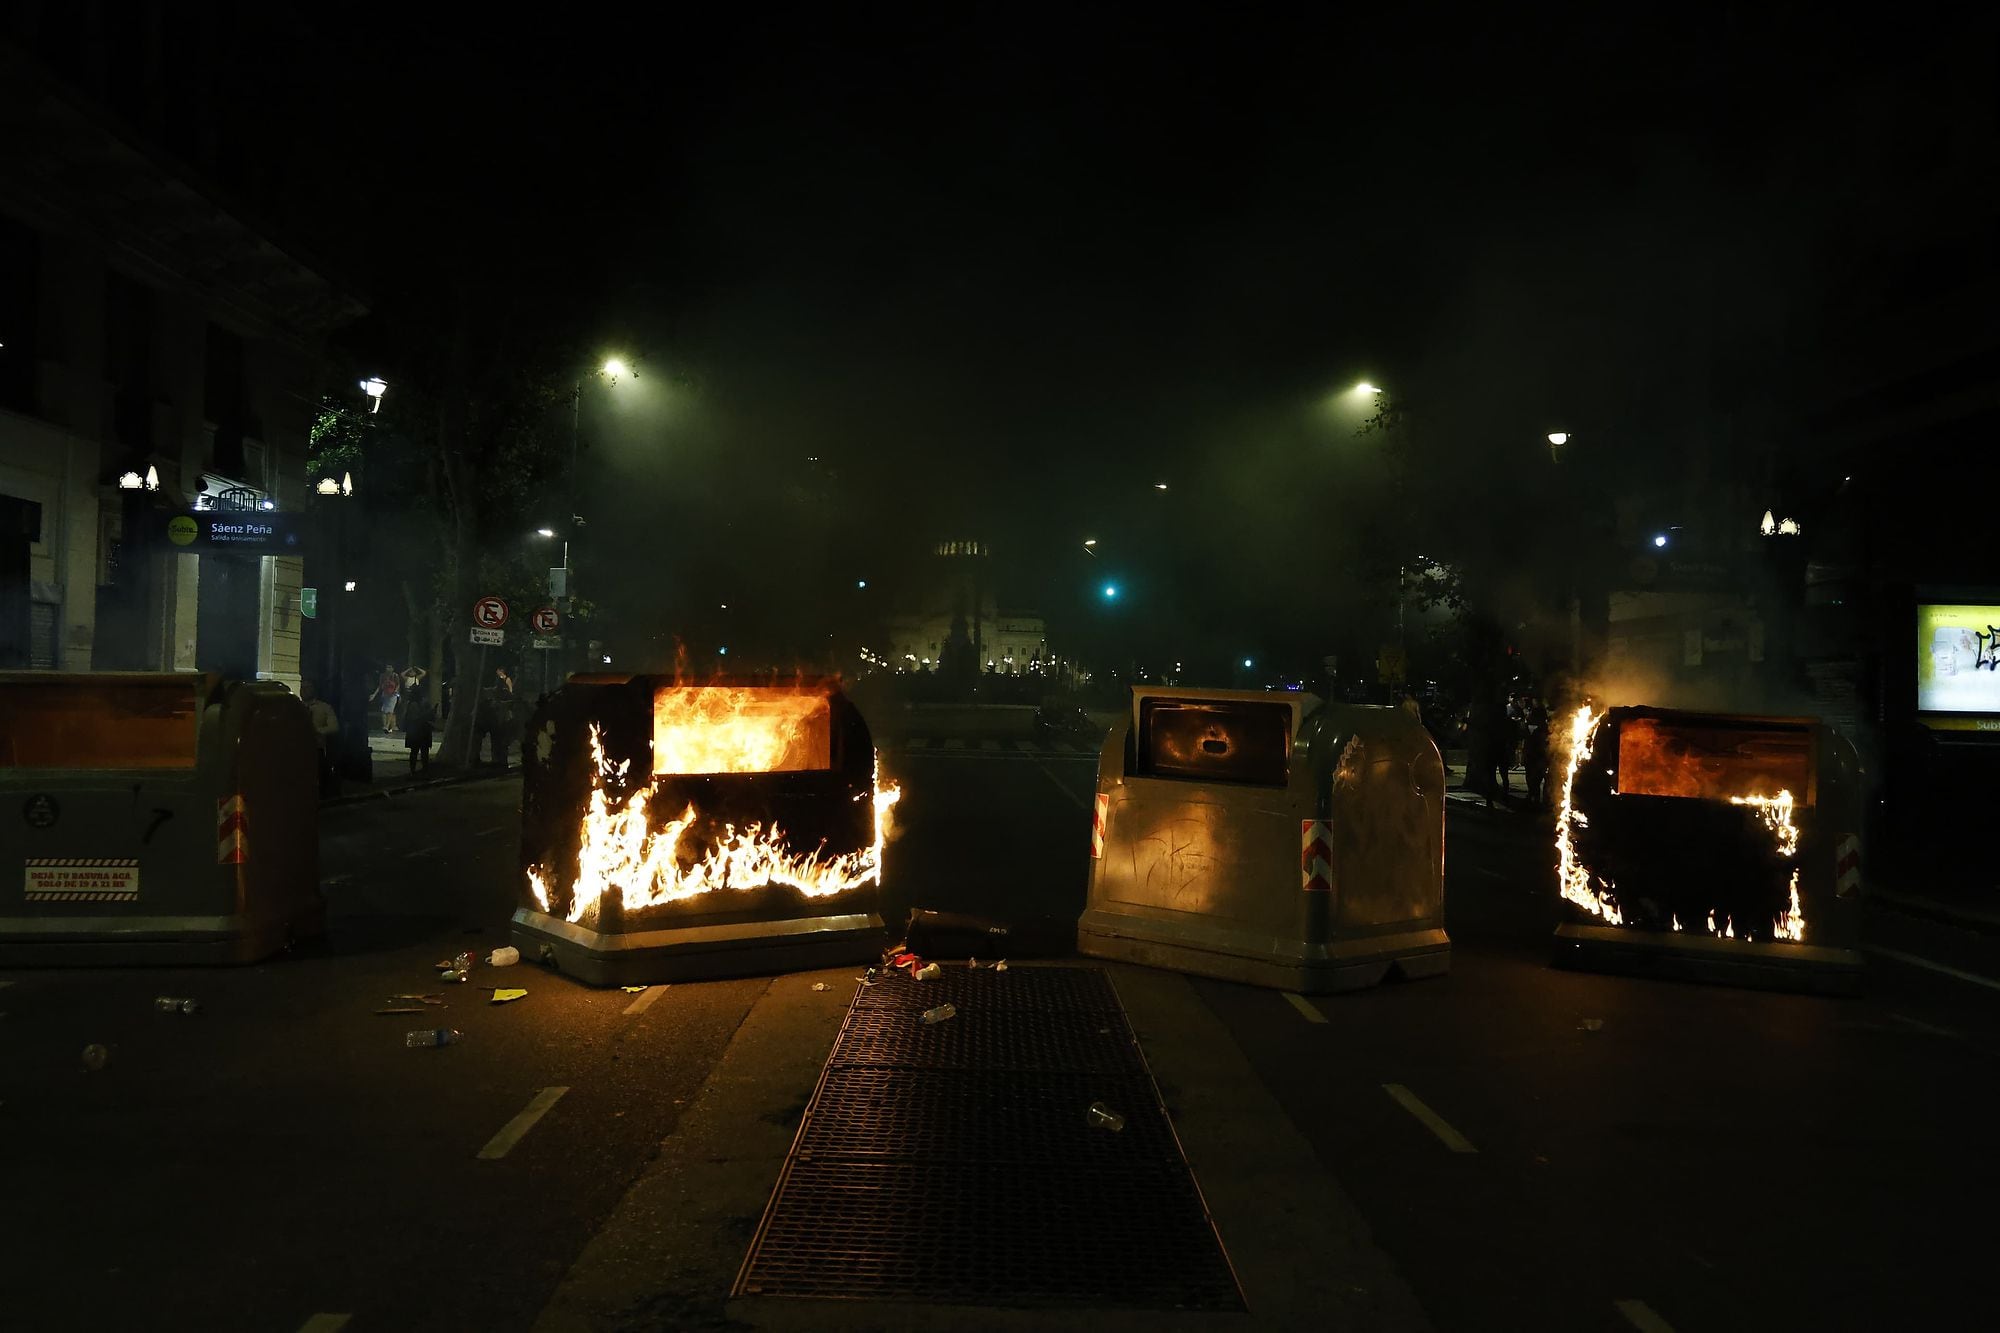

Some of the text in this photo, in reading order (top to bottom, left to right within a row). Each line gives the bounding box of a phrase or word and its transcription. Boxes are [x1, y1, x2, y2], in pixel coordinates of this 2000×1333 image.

[211, 521, 273, 535] Sáenz Peña
[58, 872, 70, 880] TU
[71, 872, 110, 880] BASURA
[37, 880, 62, 888] SOLO
[63, 880, 77, 888] DE
[79, 880, 89, 888] 19
[91, 880, 98, 888] A
[100, 880, 110, 888] 21
